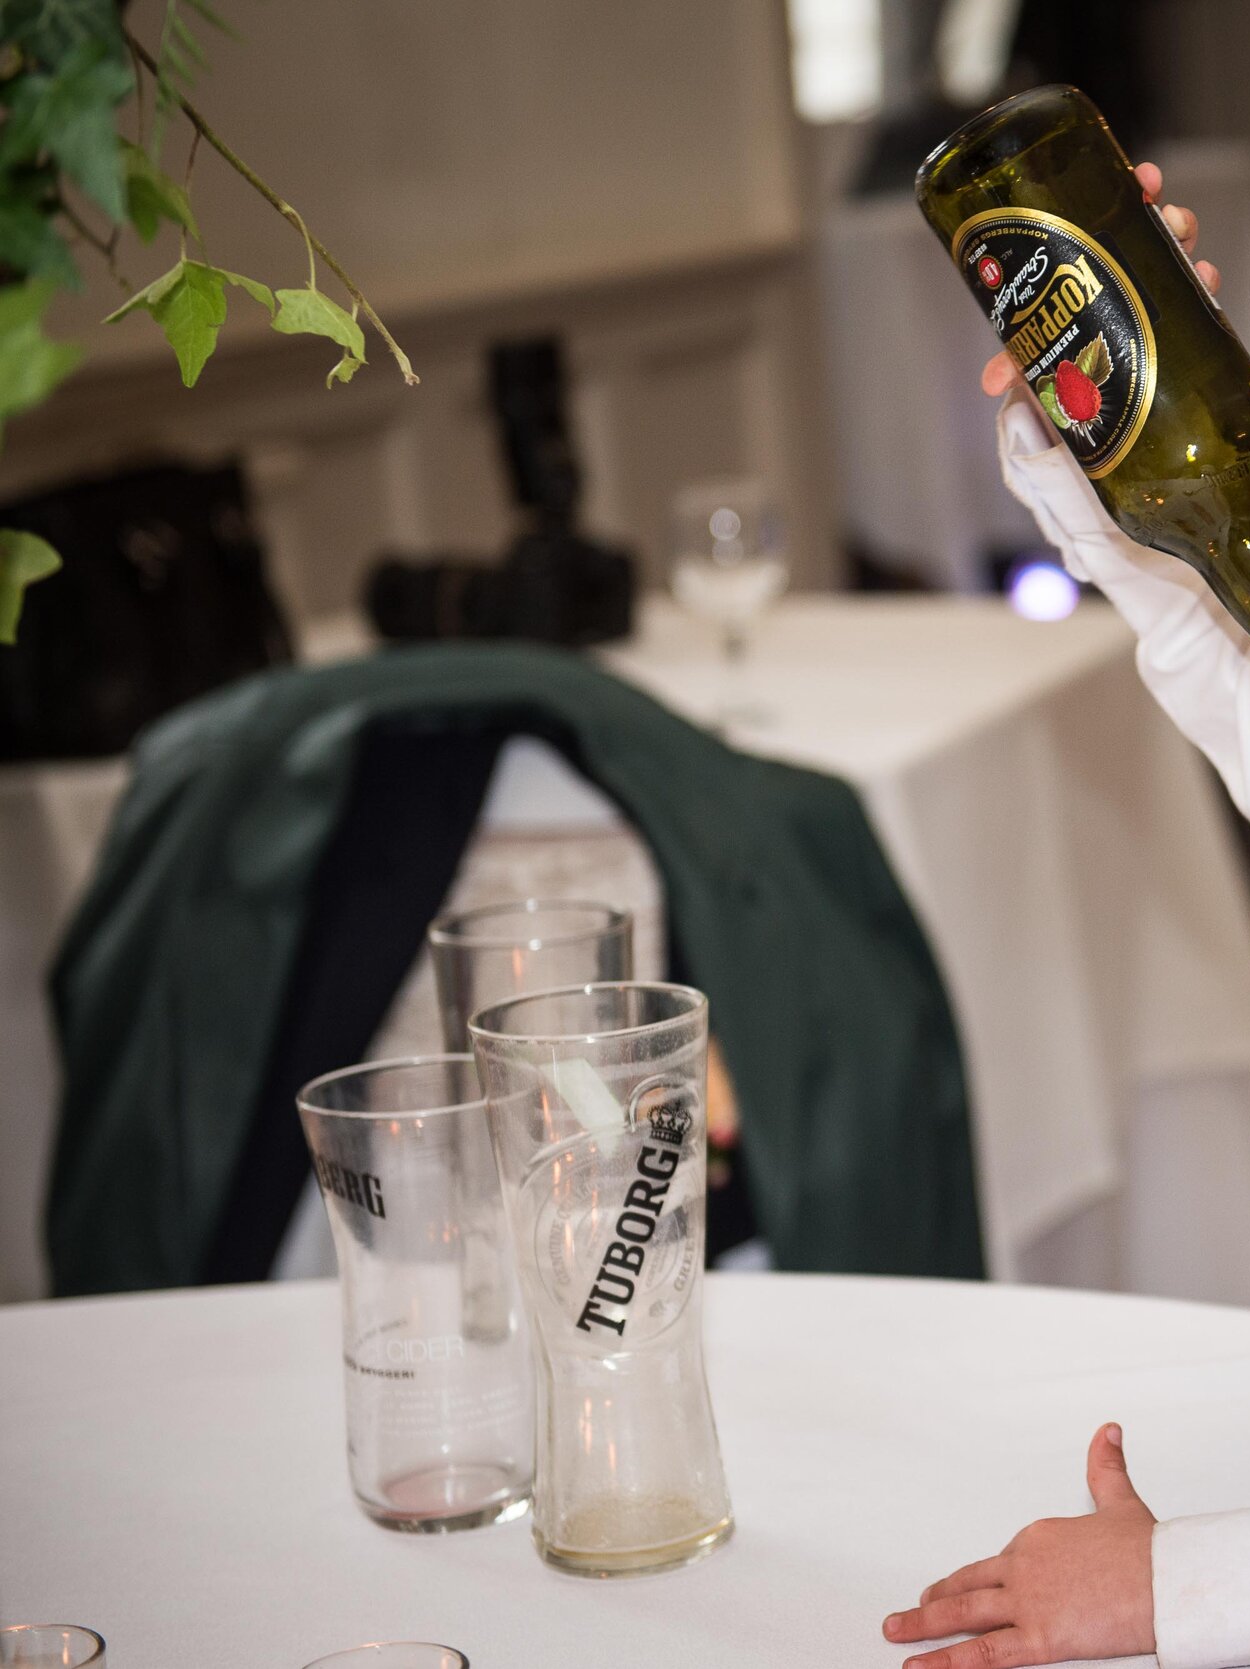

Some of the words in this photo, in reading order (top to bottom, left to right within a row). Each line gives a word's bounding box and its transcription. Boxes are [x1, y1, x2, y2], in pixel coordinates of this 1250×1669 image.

[981, 226, 1049, 240] KOPPARBERGS
[1005, 254, 1104, 370] KOPPARB
[1038, 323, 1080, 370] PREMIUM
[1117, 405, 1130, 428] APPLE
[316, 1154, 386, 1219] BERG
[576, 1145, 680, 1337] TUBORG
[386, 1333, 465, 1365] CIDER
